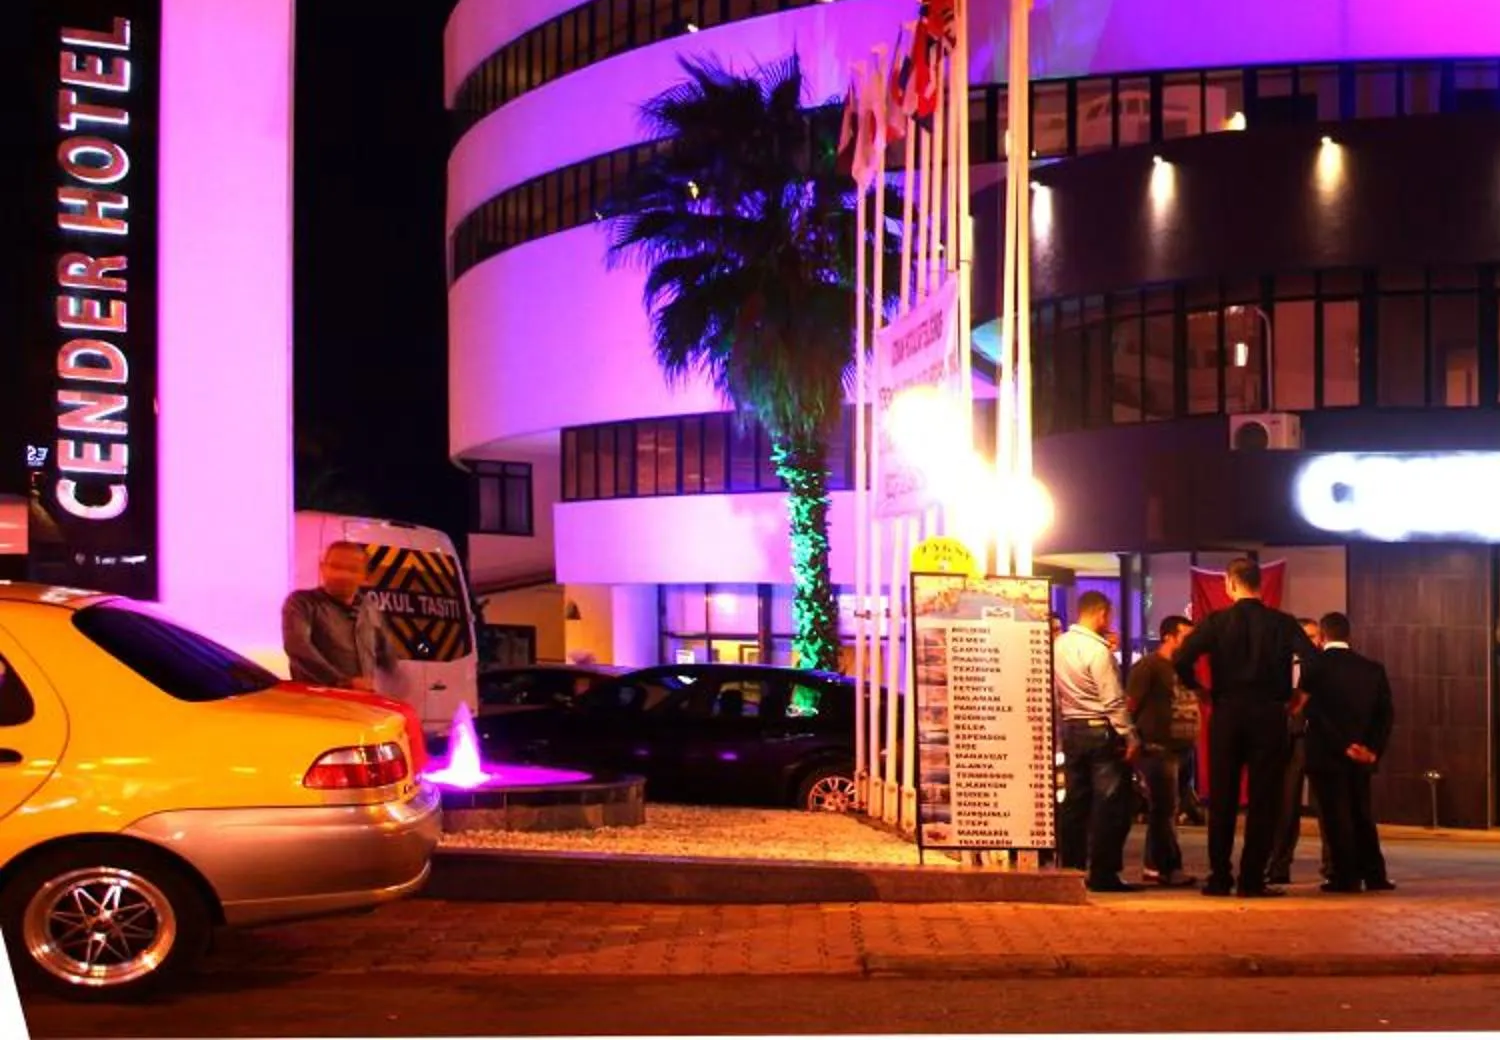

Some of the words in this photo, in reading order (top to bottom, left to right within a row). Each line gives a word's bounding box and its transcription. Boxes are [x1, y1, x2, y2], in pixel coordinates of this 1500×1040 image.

[57, 16, 132, 236] HOTEL
[56, 253, 128, 521] CENDER
[366, 590, 415, 614] OKUL
